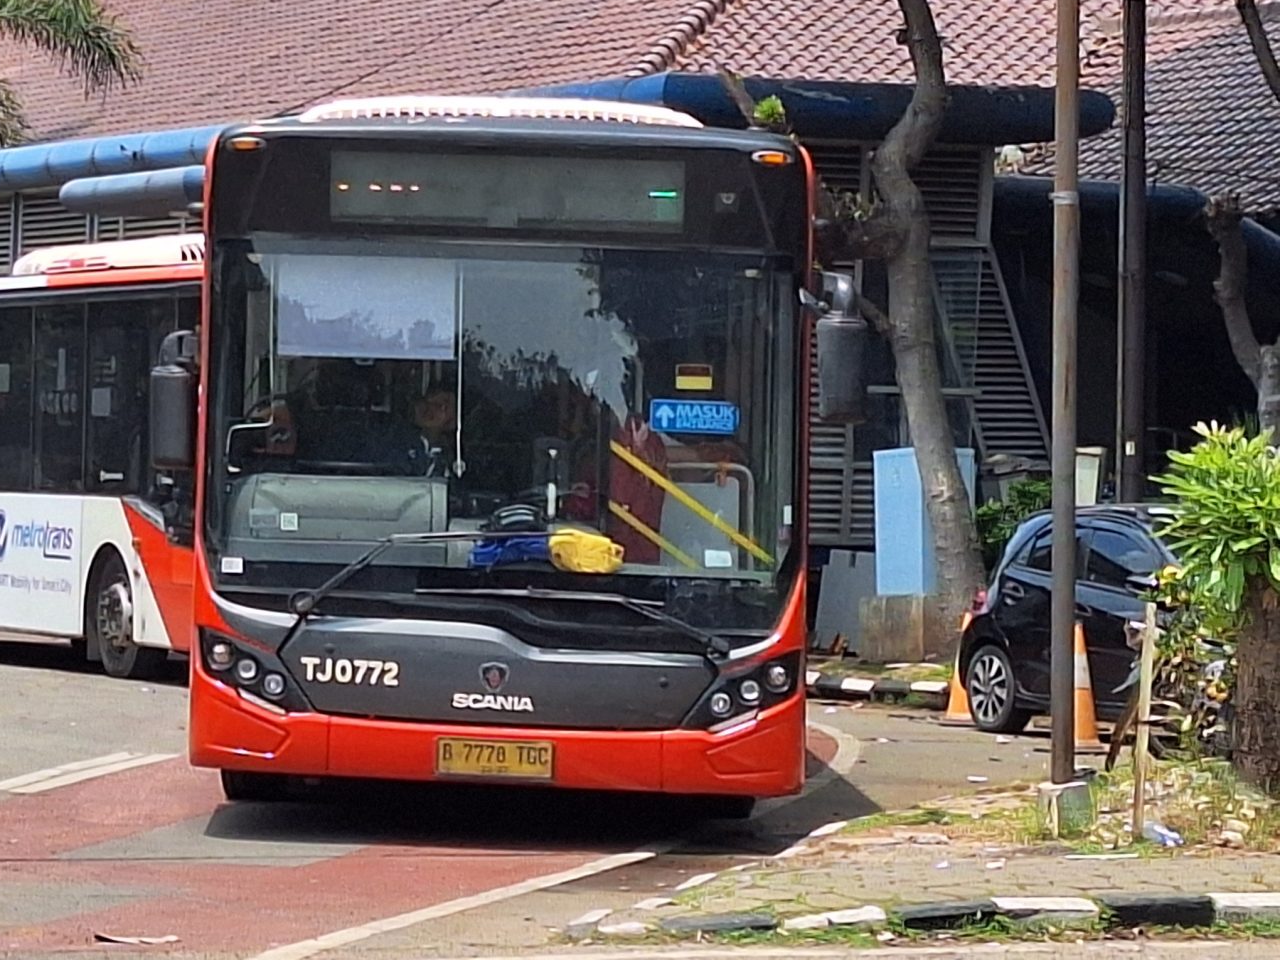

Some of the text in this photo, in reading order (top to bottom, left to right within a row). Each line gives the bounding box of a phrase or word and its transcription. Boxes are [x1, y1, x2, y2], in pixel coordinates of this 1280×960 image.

[676, 404, 735, 420] MASUK
[11, 520, 73, 558] metrotrans
[300, 656, 400, 686] TJ0772
[452, 693, 534, 712] SCANIA
[443, 742, 453, 761] B
[516, 745, 549, 766] TGC
